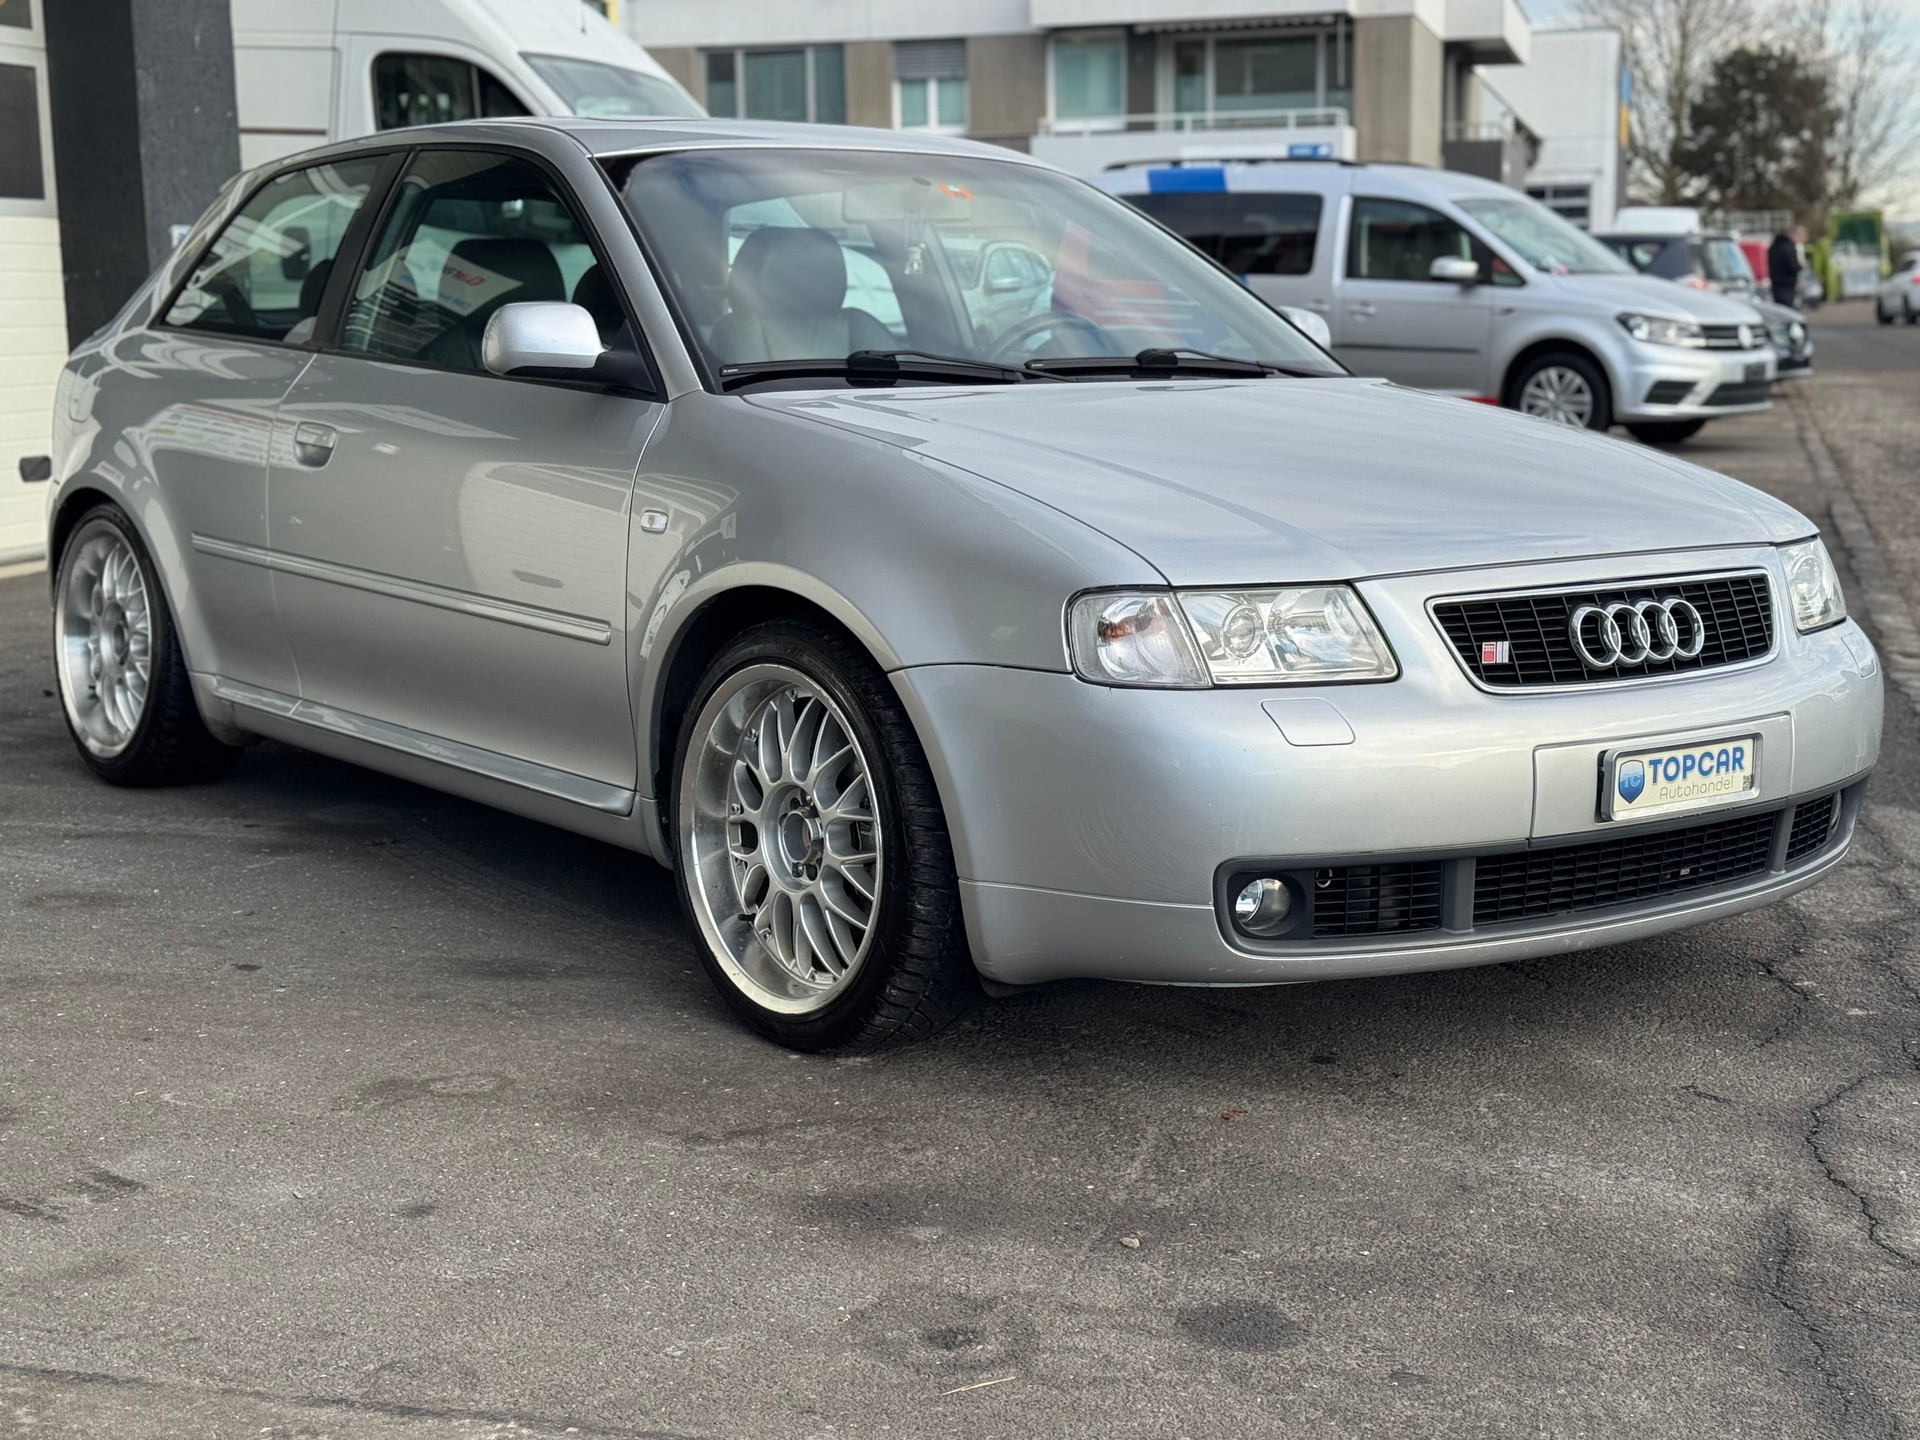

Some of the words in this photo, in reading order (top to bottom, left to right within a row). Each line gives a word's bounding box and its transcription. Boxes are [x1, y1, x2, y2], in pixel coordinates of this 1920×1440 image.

[1648, 747, 1745, 784] TOPCAR
[1622, 773, 1642, 788] TC
[1660, 777, 1734, 800] Autohandel
